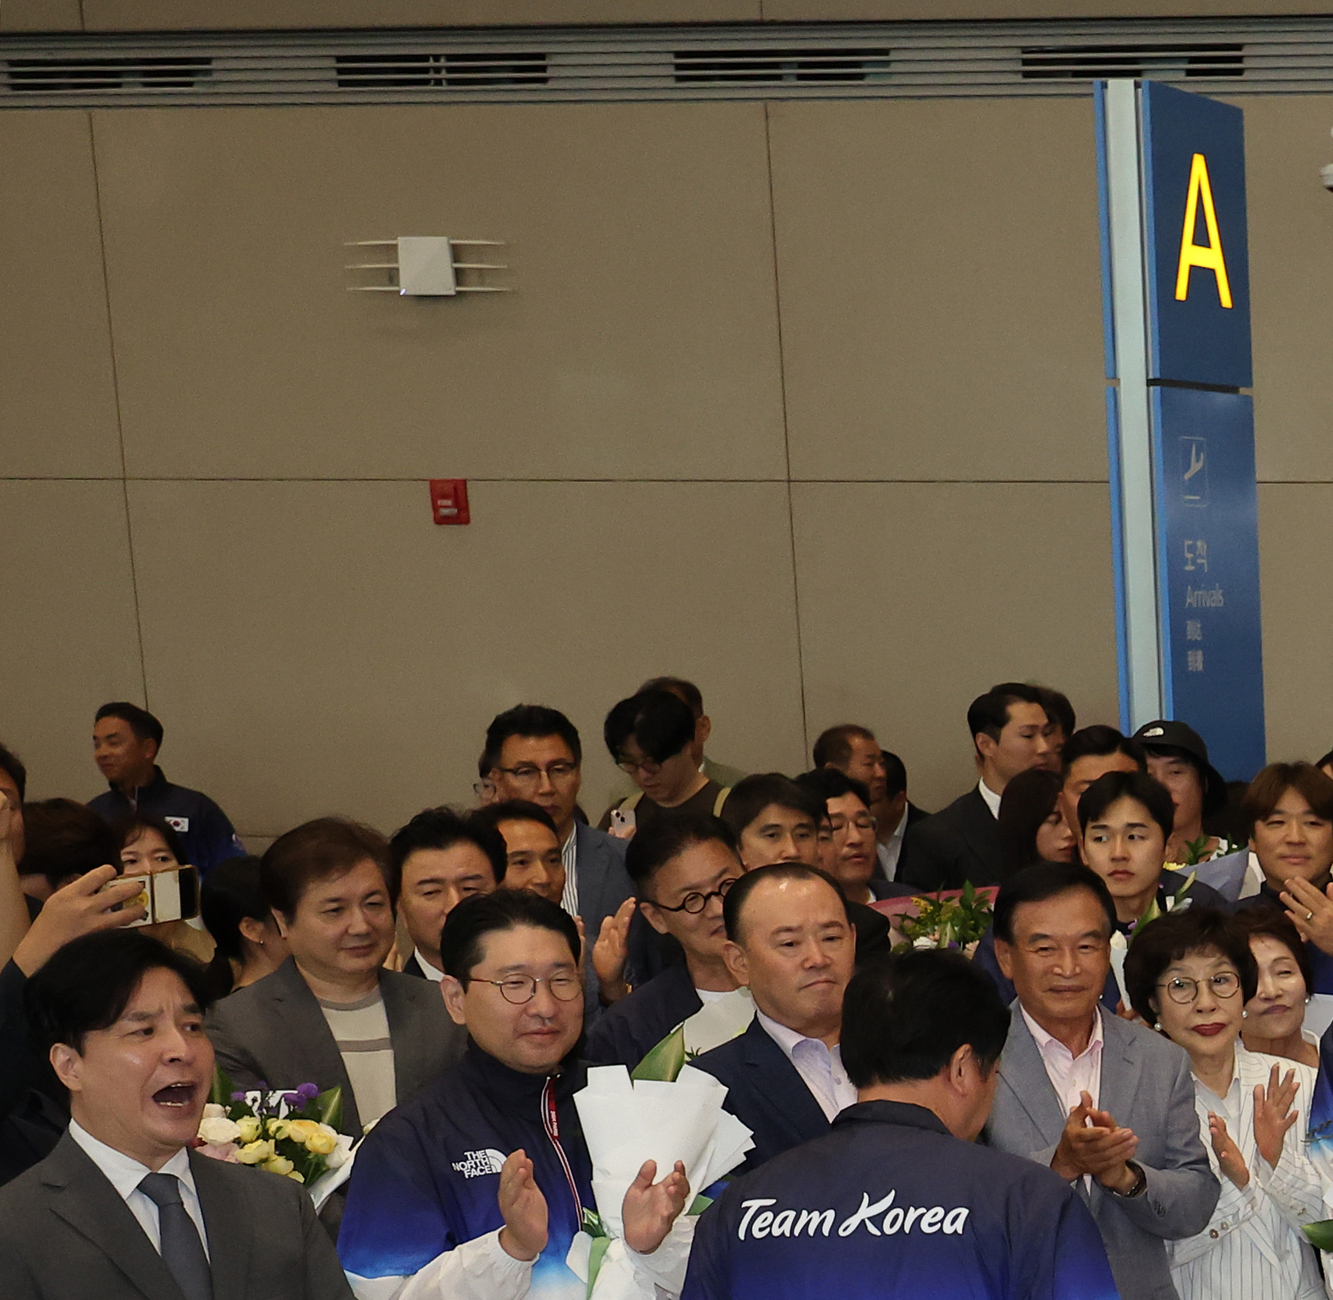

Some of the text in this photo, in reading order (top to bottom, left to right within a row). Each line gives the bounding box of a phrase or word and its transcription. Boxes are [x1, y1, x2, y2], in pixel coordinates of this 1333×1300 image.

[1174, 153, 1233, 309] A
[1184, 539, 1208, 573] 도착
[452, 1156, 490, 1172] NORTH
[464, 1149, 487, 1160] THE
[464, 1166, 494, 1179] FACE
[738, 1188, 970, 1241] Team Korea
